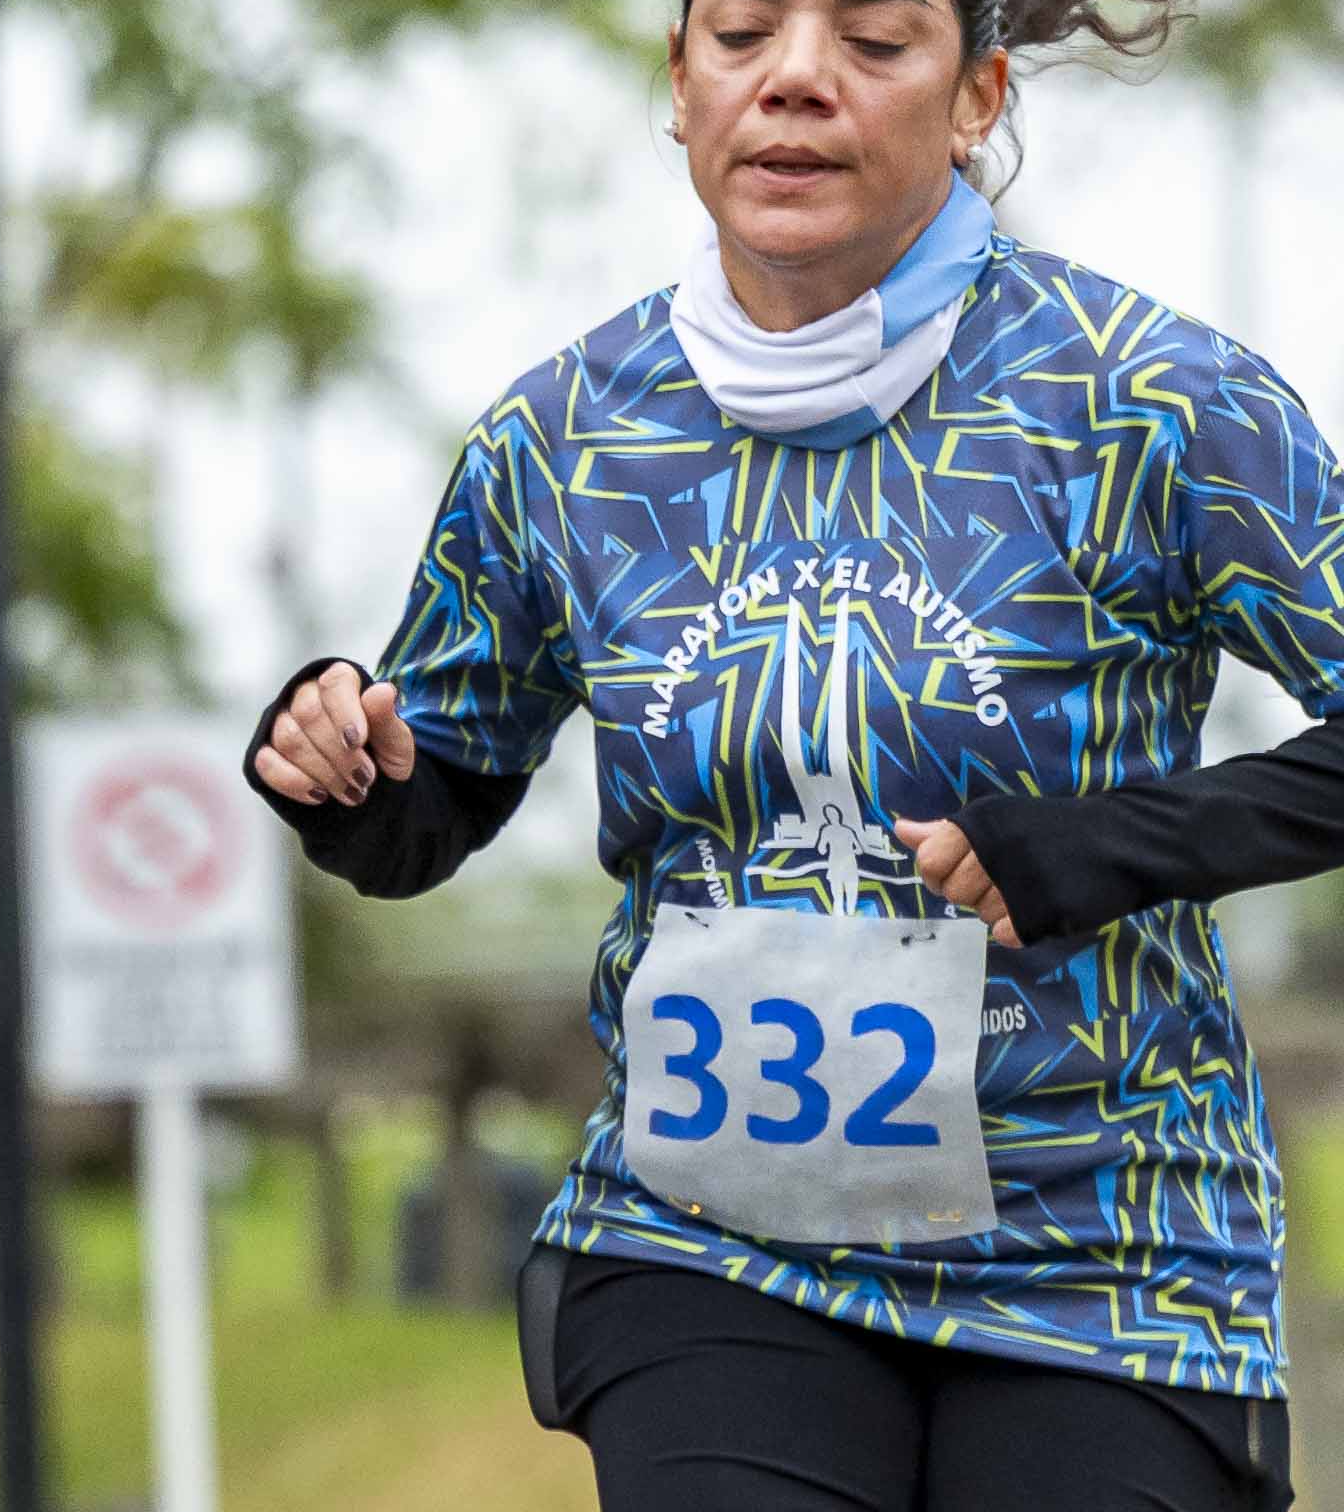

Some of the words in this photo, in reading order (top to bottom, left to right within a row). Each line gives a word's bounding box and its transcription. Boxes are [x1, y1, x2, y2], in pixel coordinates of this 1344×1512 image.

[642, 567, 781, 740] MARATÓN
[792, 558, 820, 590] X
[832, 558, 872, 592] EL
[879, 572, 1009, 727] AUTISMO
[648, 994, 941, 1148] 332
[982, 1003, 1027, 1034] IDOS
